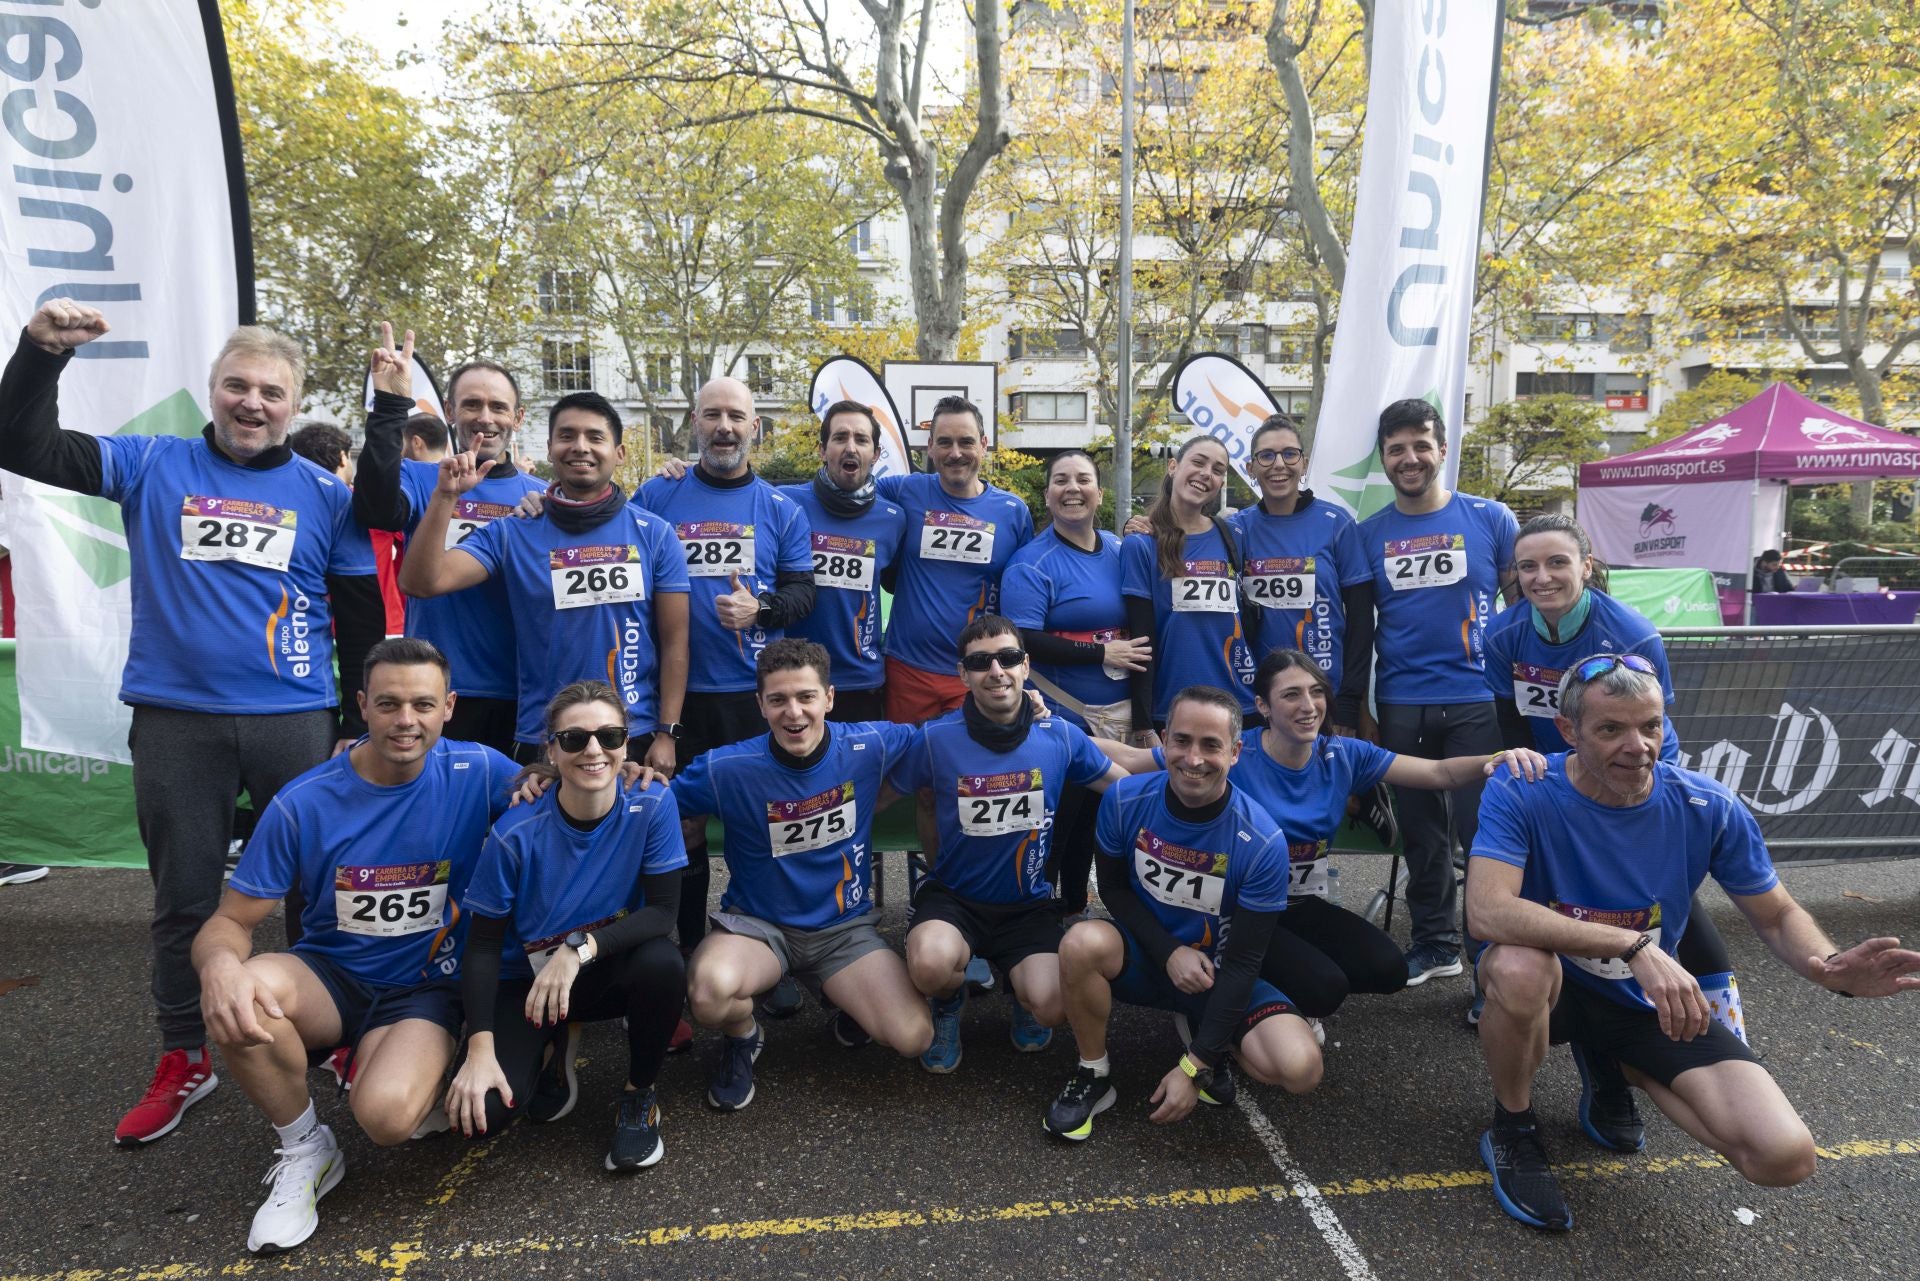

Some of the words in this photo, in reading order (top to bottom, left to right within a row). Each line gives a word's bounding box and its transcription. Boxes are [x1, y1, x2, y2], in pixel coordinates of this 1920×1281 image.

[1600, 459, 1726, 480] www.runvasport.es
[221, 504, 264, 516] EMPRESAS
[222, 500, 255, 508] CARRERA
[198, 520, 277, 553] 287
[931, 529, 982, 553] 272
[686, 542, 742, 565] 282
[812, 554, 863, 579] 288
[1395, 553, 1453, 579] 276
[565, 566, 629, 595] 266
[1183, 580, 1231, 601] 270
[1252, 577, 1303, 598] 269
[1683, 601, 1717, 612] Unica
[281, 625, 293, 655] grupo
[287, 584, 311, 678] elecnor
[1308, 630, 1316, 653] grupo
[1313, 594, 1332, 671] elecnor
[623, 617, 640, 705] elecnor
[1234, 646, 1243, 668] grupo
[1527, 686, 1559, 709] 28
[986, 774, 1009, 782] CARRERA
[986, 780, 1017, 789] EMPRESAS
[971, 795, 1031, 823] 274
[784, 809, 845, 844] 275
[1162, 843, 1188, 856] CARRERA
[1162, 848, 1196, 863] EMPRESAS
[376, 866, 407, 875] CARRERA
[1027, 849, 1036, 874] grupo
[375, 872, 417, 882] EMPRESAS
[1144, 859, 1204, 900] 271
[352, 890, 431, 922] 265
[1589, 910, 1621, 919] CARRERA
